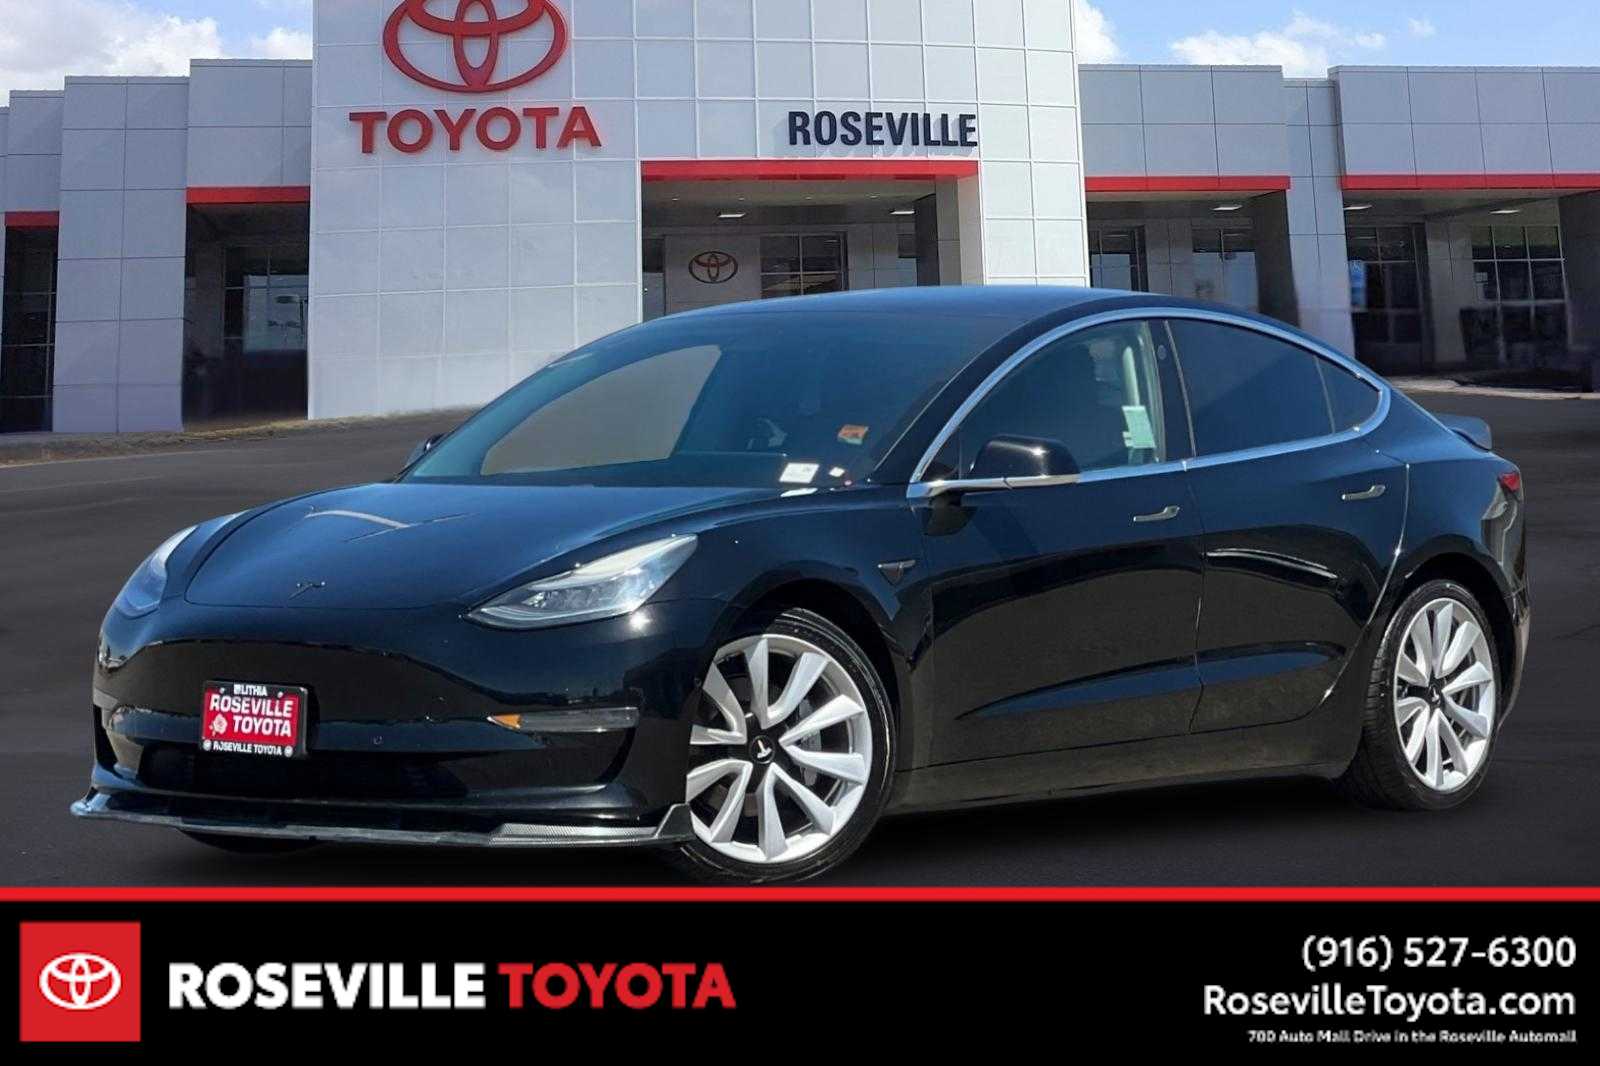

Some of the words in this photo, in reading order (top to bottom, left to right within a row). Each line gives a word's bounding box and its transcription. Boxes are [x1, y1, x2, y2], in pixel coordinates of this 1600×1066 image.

[349, 106, 602, 154] TOYOTA
[788, 111, 978, 147] ROSEVILLE
[241, 684, 268, 696] LITHIA
[209, 693, 293, 718] ROSEVILLE
[232, 715, 292, 737] TOYOTA
[213, 741, 252, 753] ROSEVILLE
[254, 743, 282, 755] TOYOTA
